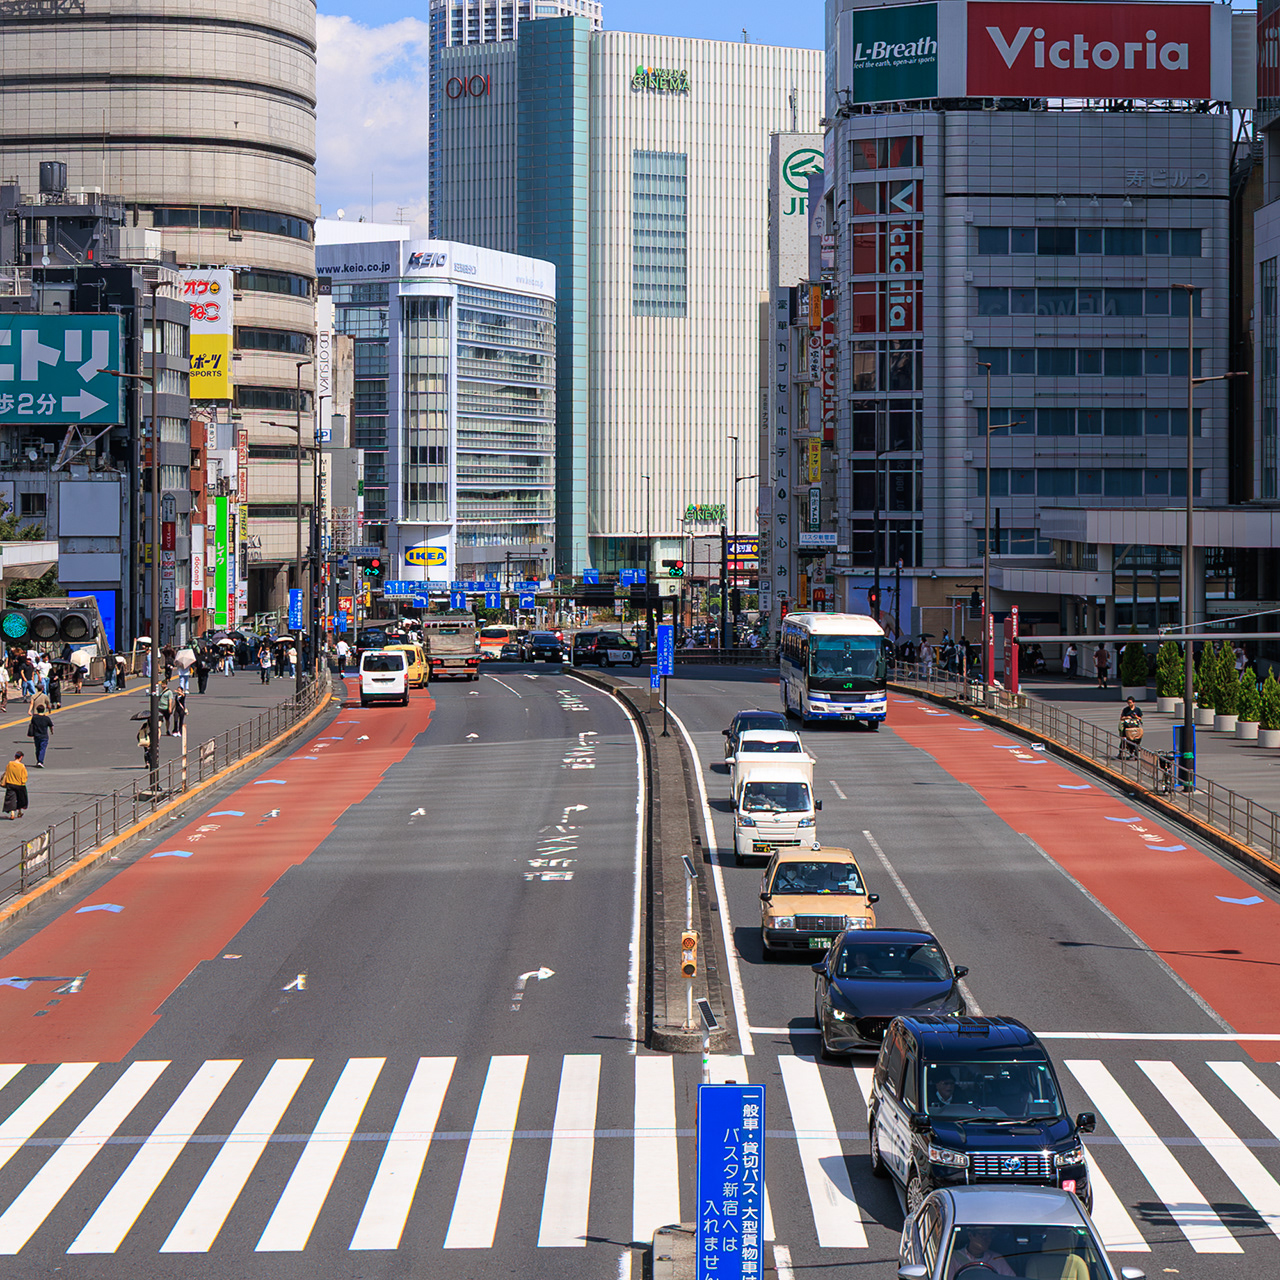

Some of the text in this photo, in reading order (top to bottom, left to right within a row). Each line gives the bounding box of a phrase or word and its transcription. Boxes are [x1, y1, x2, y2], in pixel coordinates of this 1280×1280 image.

[985, 25, 1189, 71] Victoria
[632, 74, 691, 91] CINEMA
[408, 252, 448, 267] KEIO
[889, 183, 913, 327] Victoria
[317, 262, 391, 274] www.keio.co.jp
[685, 510, 728, 521] CINEMA
[407, 551, 445, 563] IKEA
[722, 1128, 740, 1252] バスタ新宿へは
